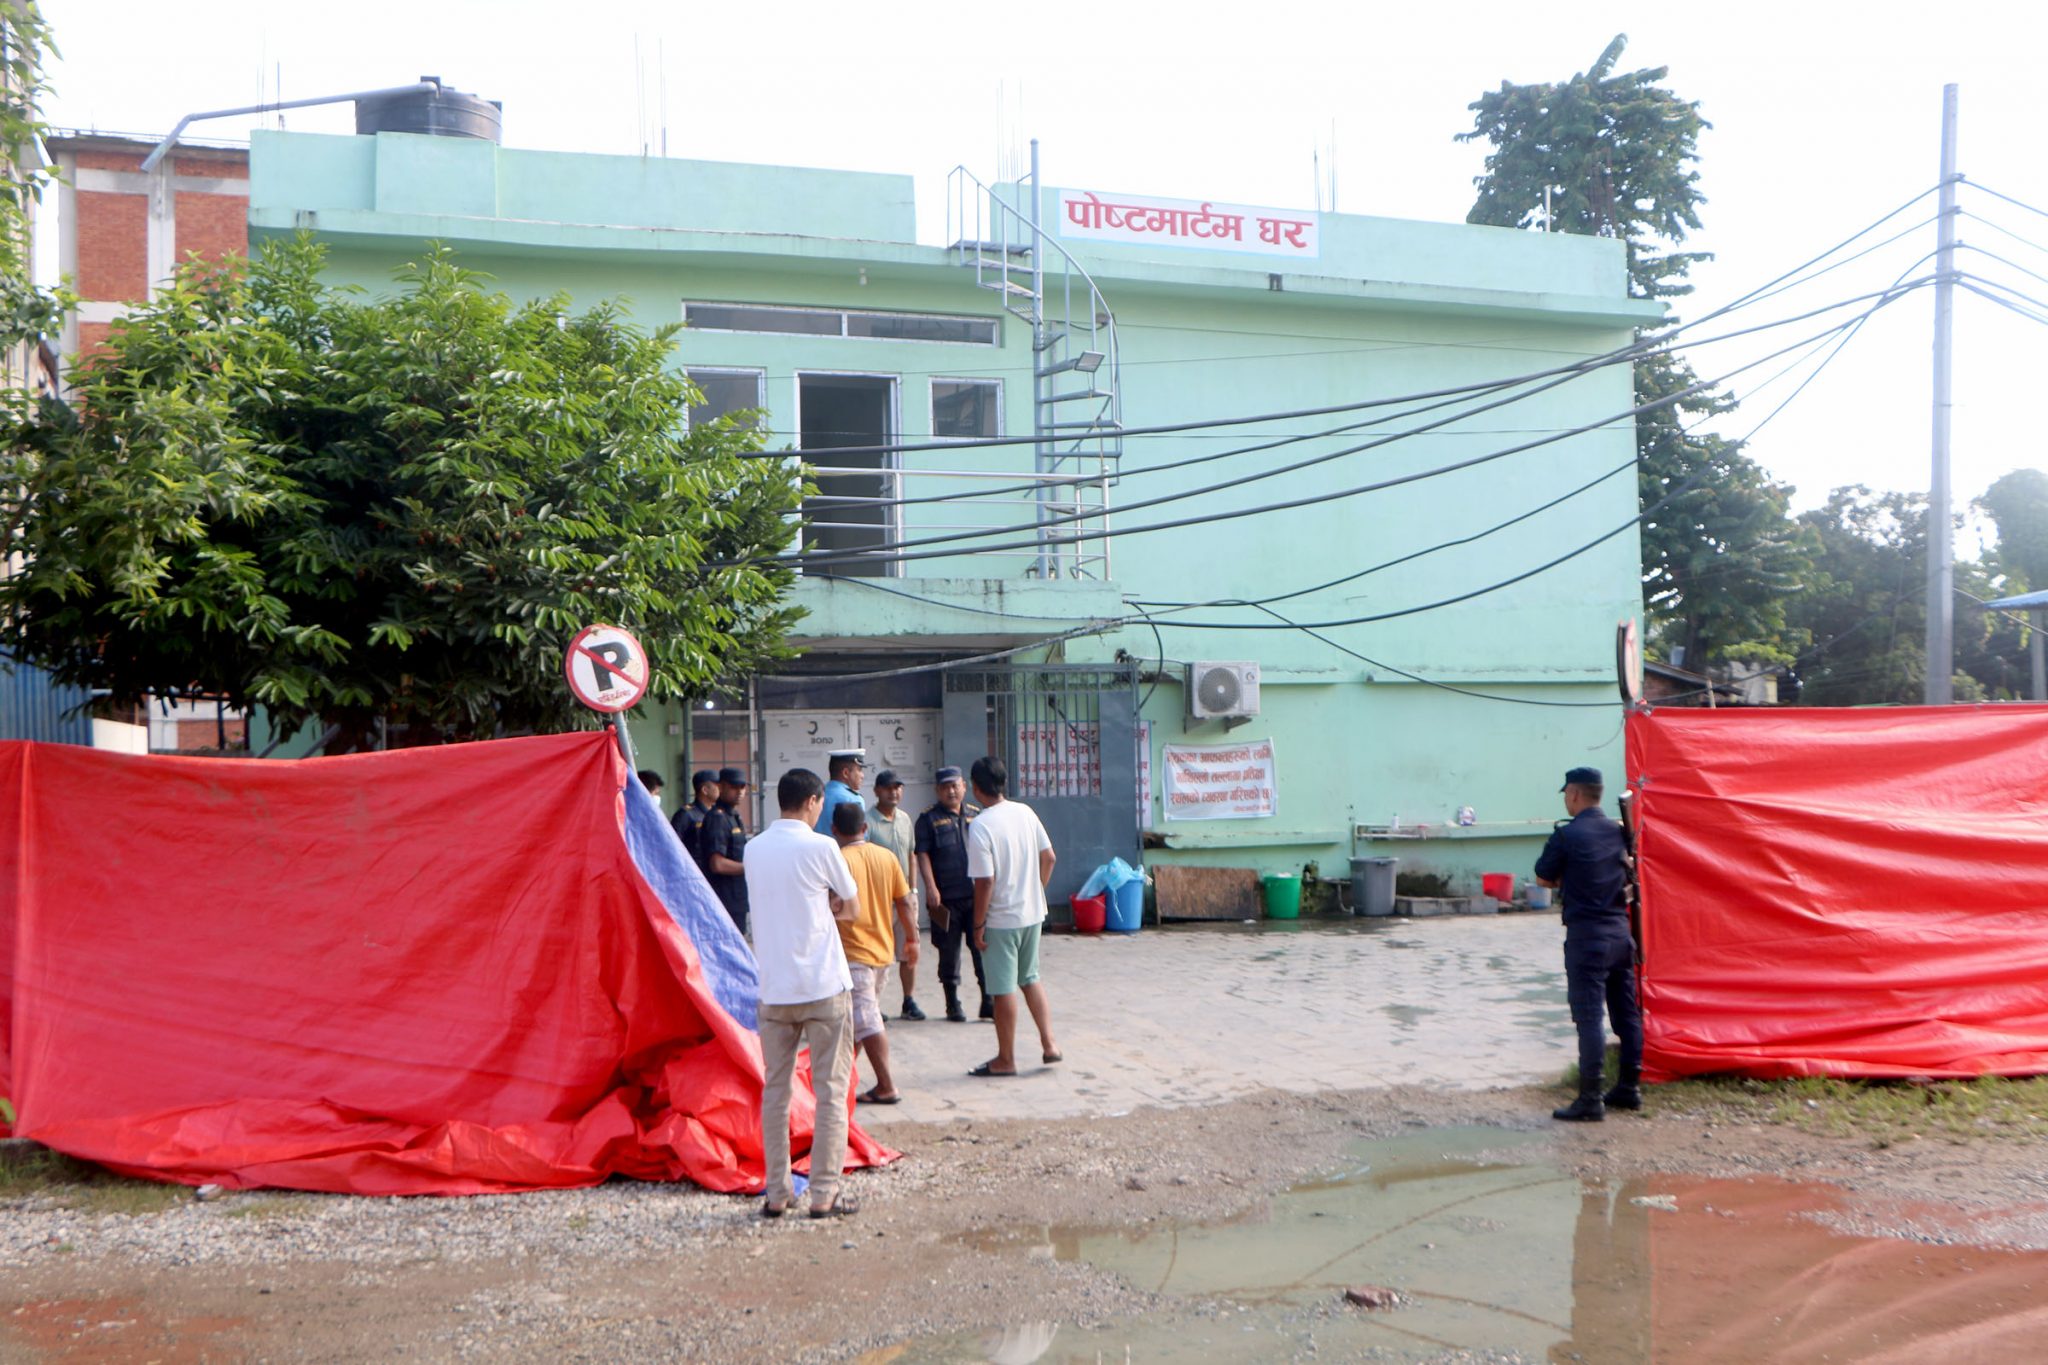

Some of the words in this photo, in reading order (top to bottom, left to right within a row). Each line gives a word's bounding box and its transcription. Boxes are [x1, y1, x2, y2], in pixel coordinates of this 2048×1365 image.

[1065, 191, 1244, 241] पोष्टमार्टम
[1256, 217, 1313, 248] घर
[588, 641, 630, 691] P
